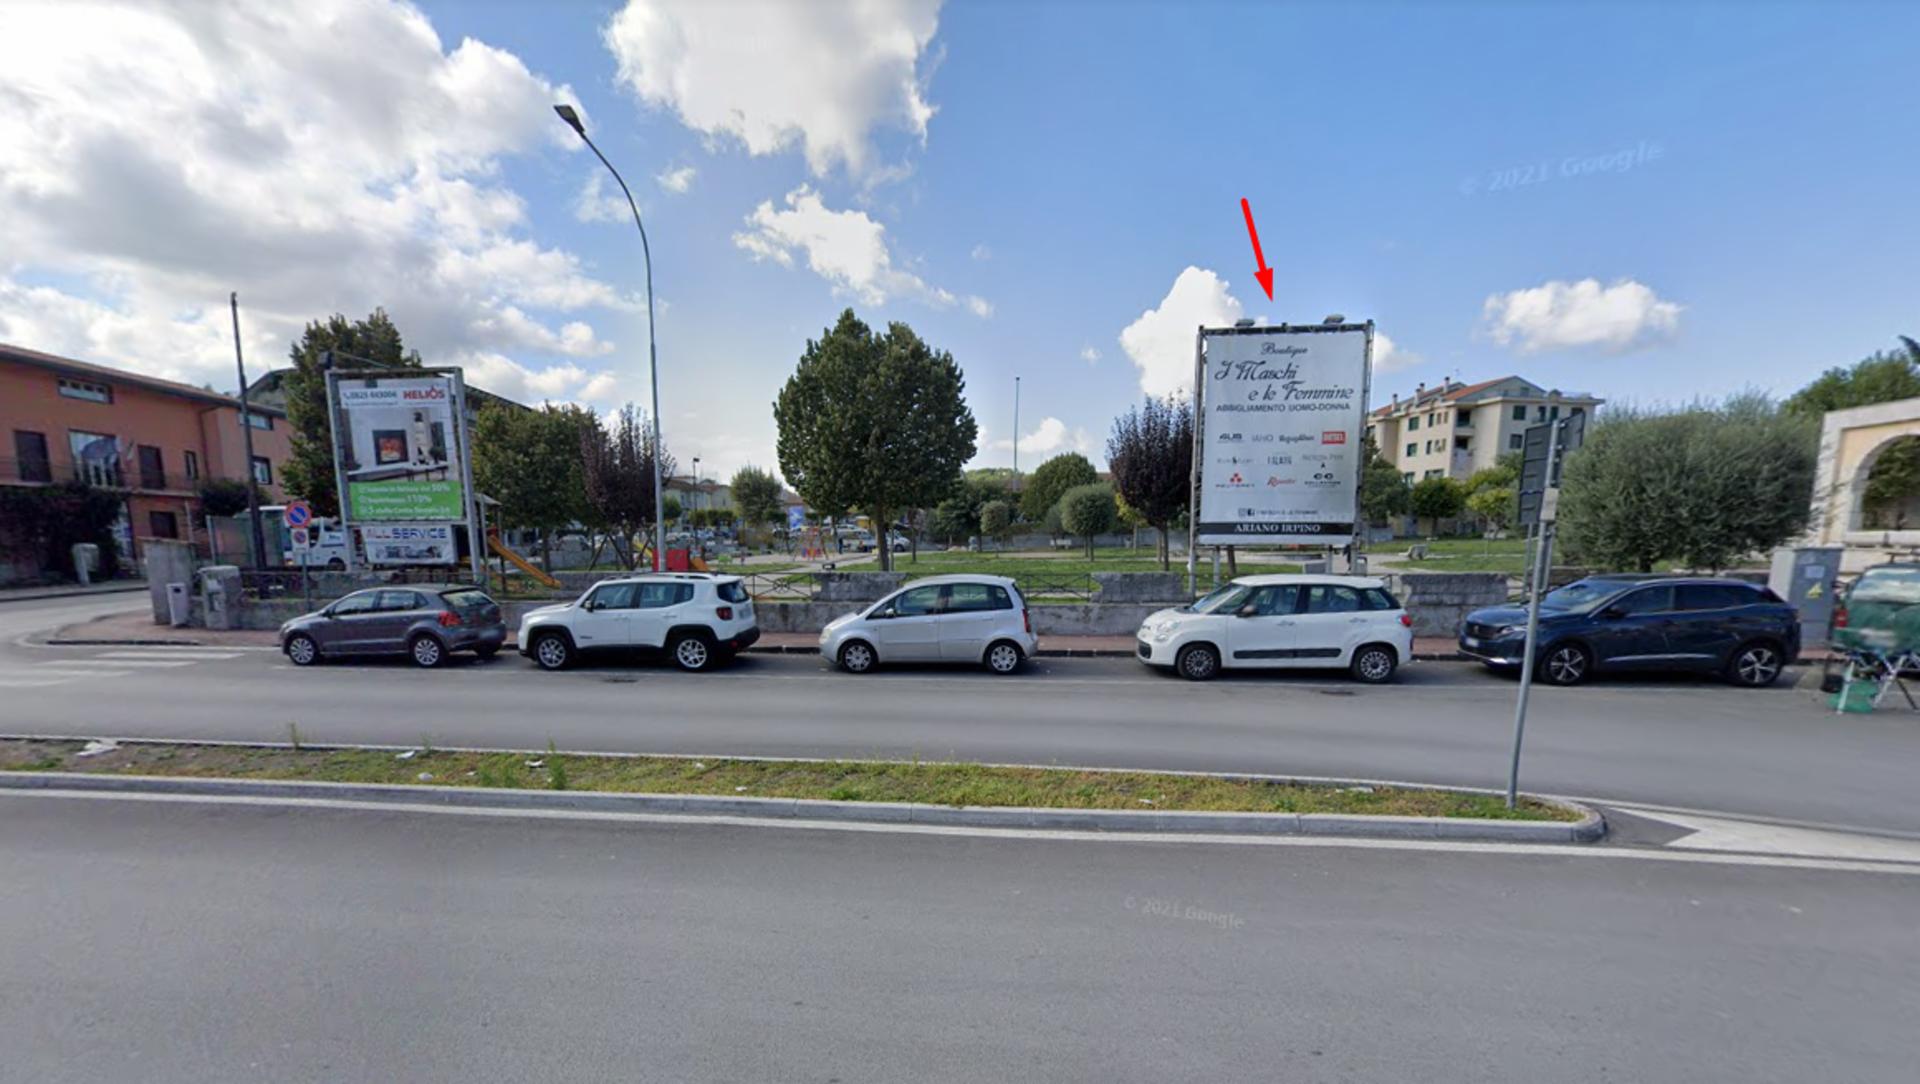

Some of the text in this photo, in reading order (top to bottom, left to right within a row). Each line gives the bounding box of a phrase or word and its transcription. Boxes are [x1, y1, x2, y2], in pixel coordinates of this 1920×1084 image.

[1260, 342, 1309, 358] Boutique
[1235, 360, 1300, 381] Maschi
[1248, 380, 1354, 401] e le Femmine
[1216, 403, 1351, 412] ABBIGLIAMENTO UOMO-DONNA
[392, 527, 447, 539] SERVICE
[1234, 524, 1321, 532] ARIANO IRPINO
